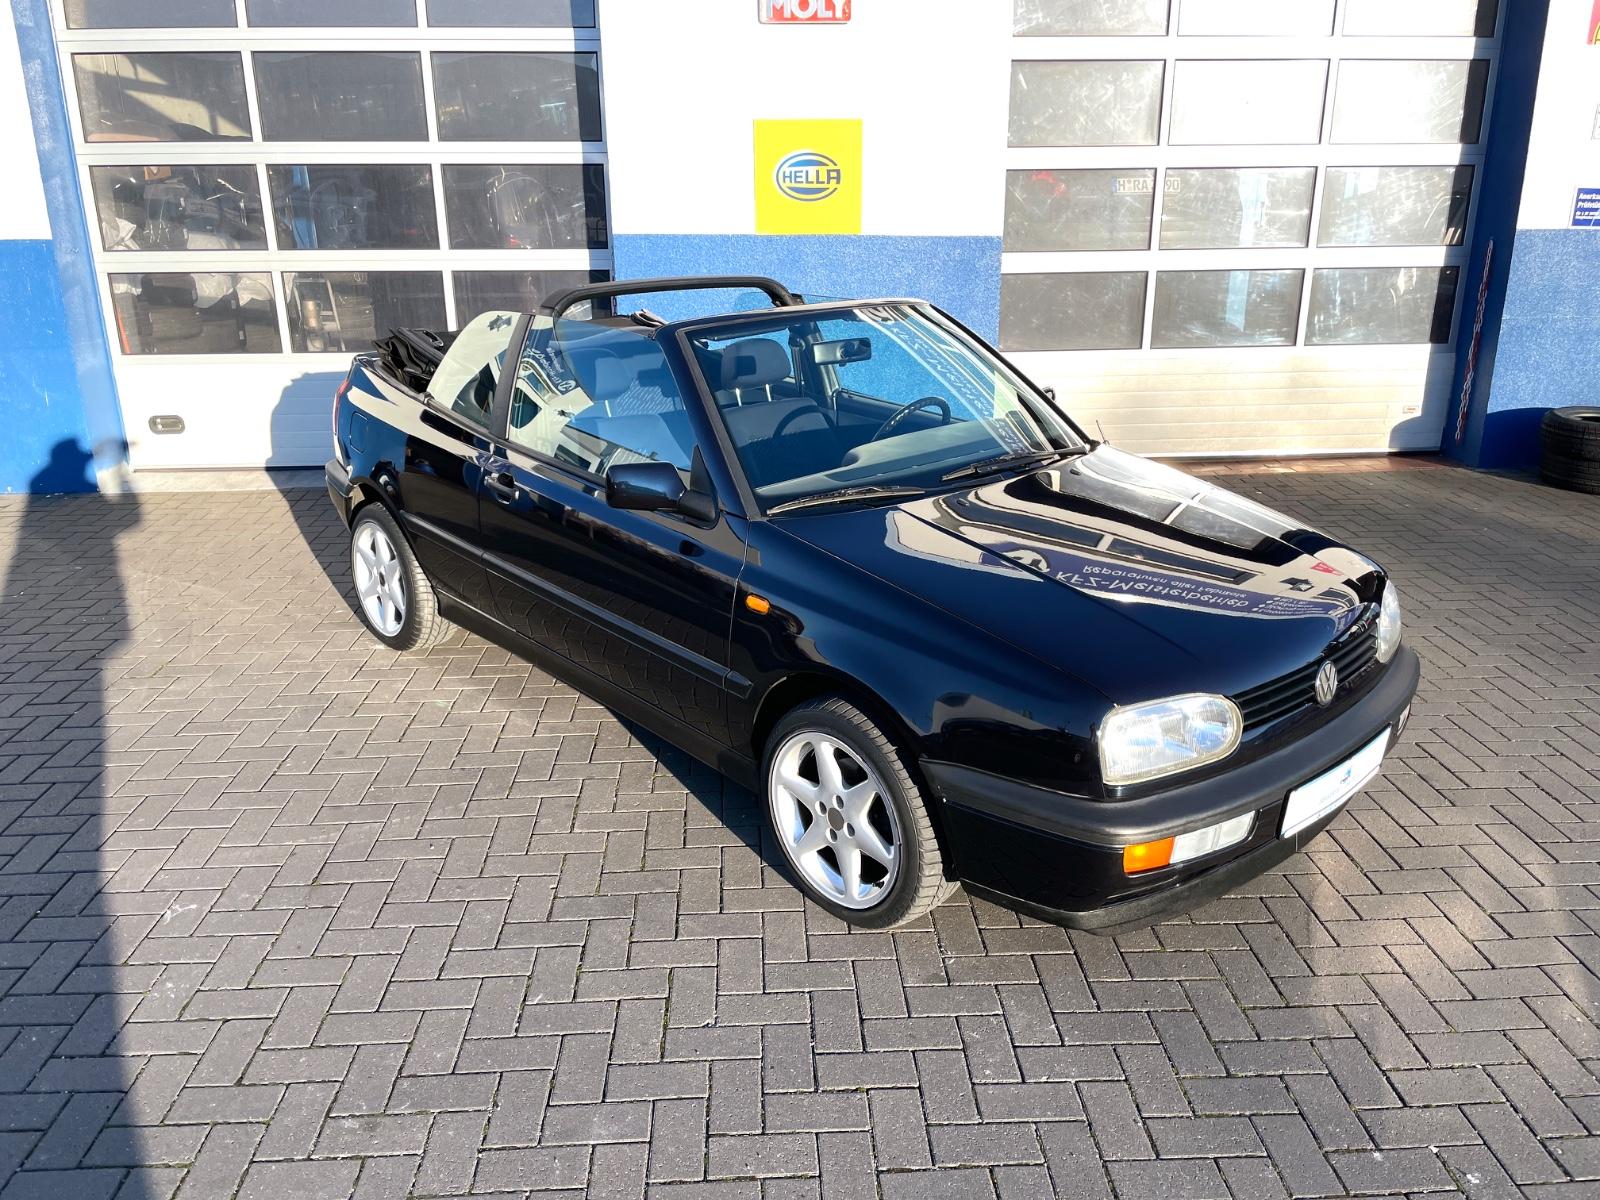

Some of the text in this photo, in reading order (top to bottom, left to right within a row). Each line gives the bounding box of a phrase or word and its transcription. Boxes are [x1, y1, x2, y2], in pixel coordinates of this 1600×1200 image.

[766, 0, 846, 18] MOLY
[783, 168, 841, 185] HELLA
[1117, 179, 1126, 191] H
[1133, 179, 1148, 191] RA
